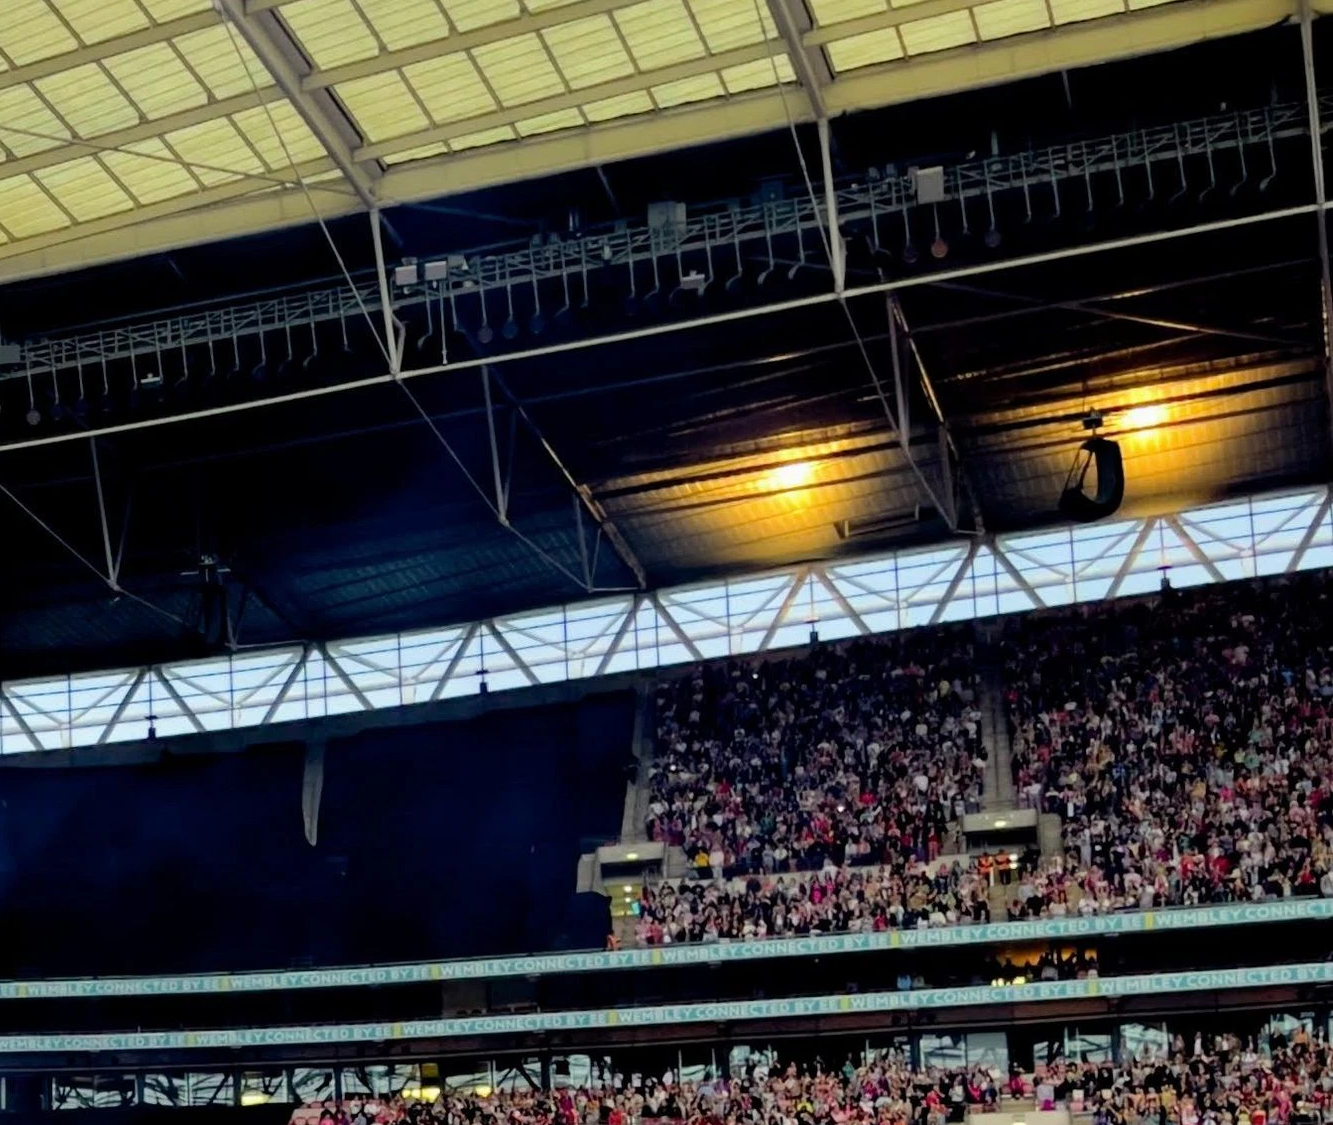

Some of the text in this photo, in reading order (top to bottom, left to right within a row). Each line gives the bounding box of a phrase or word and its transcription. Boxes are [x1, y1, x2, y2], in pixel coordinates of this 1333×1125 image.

[1156, 907, 1241, 927] WEMBLEY
[900, 928, 982, 946] WEMBLEY
[986, 919, 1089, 939] CONNECTED
[1095, 917, 1116, 931] BY
[662, 946, 740, 963] WEMBLEY
[742, 939, 836, 958] CONNECTED
[844, 936, 866, 950] BY
[441, 962, 510, 977] WEMBLEY
[514, 955, 603, 973] CONNECTED
[609, 953, 628, 966] BY
[1099, 975, 1184, 993] WEMBLEY
[1188, 968, 1290, 987] CONNECTED
[1297, 966, 1318, 980] BY
[850, 992, 931, 1009] WEMBLEY
[933, 985, 1033, 1004] CONNECTED
[1040, 983, 1061, 997] BY
[618, 1007, 692, 1023] WEMBLEY
[695, 1001, 788, 1018] CONNECTED
[794, 999, 814, 1013] BY
[402, 1020, 472, 1036] WEMBLEY
[475, 1015, 559, 1032] CONNECTED
[566, 1013, 585, 1026] BY
